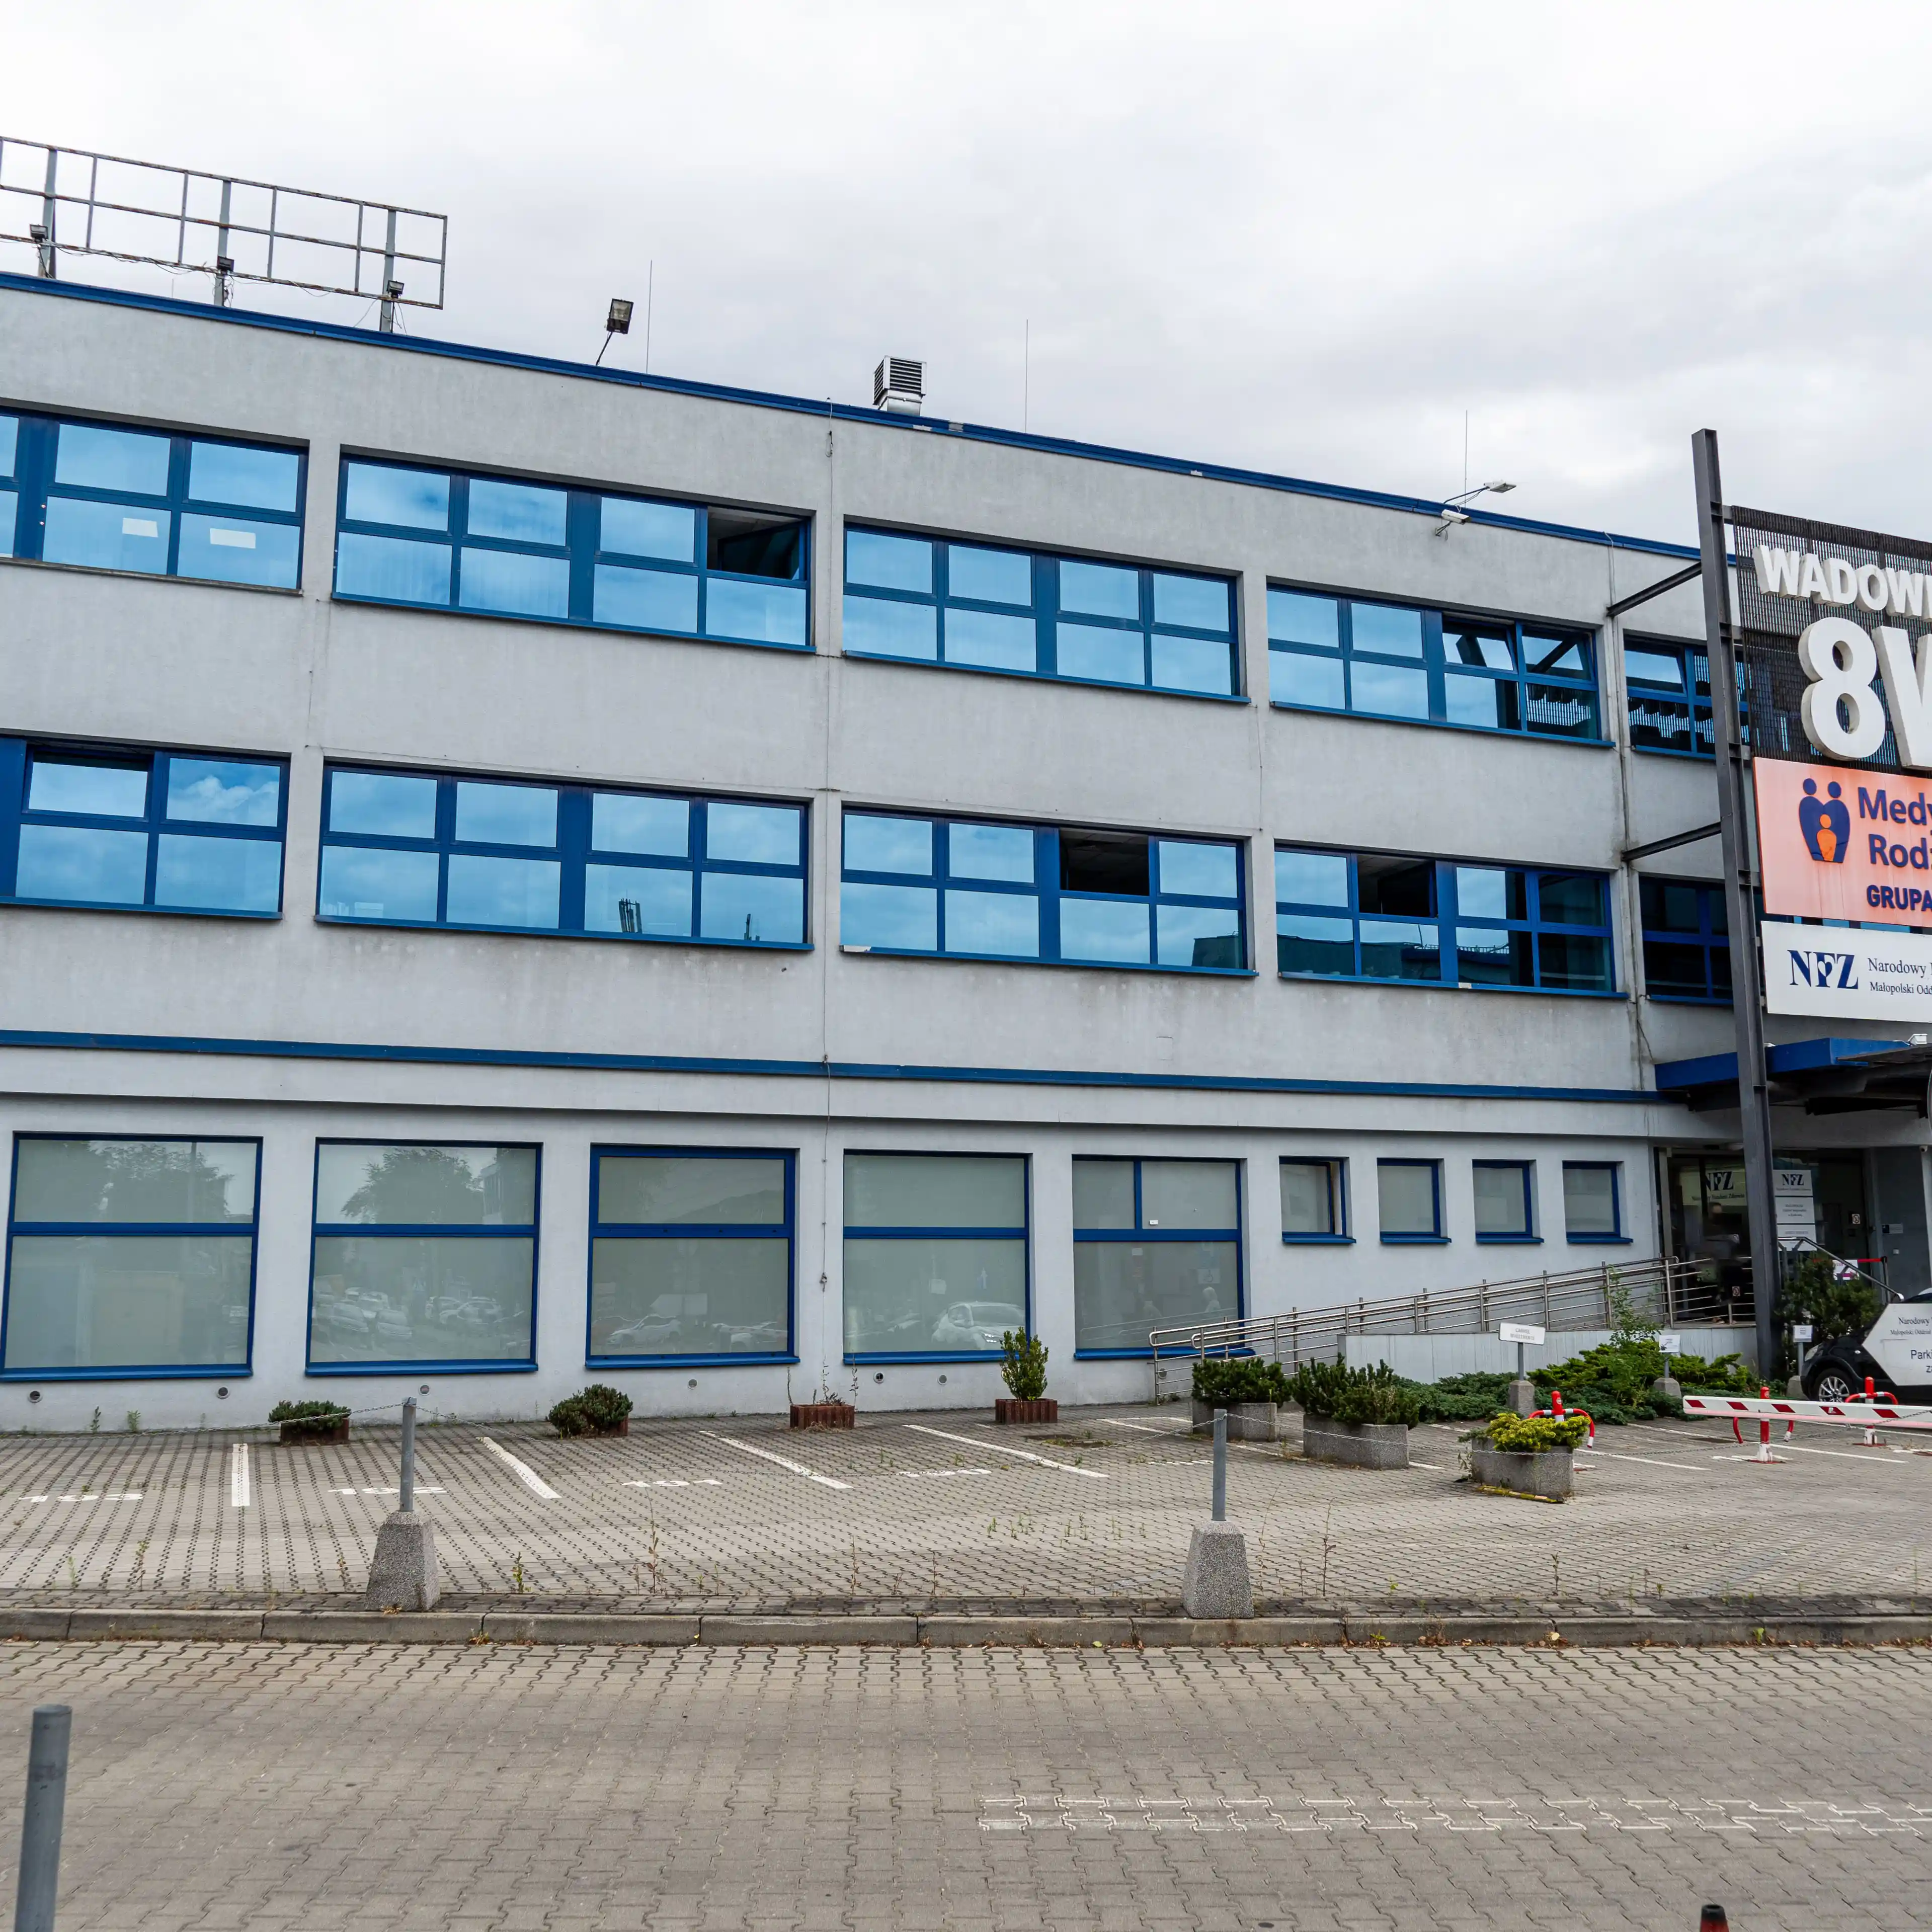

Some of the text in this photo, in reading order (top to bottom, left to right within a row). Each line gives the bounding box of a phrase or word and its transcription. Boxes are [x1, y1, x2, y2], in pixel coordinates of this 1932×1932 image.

[1868, 834, 1932, 870] Rod
[1787, 949, 1859, 990] NFZ
[1868, 957, 1926, 978] Narodowy
[1869, 981, 1914, 995] Małopolski
[1782, 1174, 1804, 1185] NFZ
[1898, 1317, 1929, 1326] Narodowy
